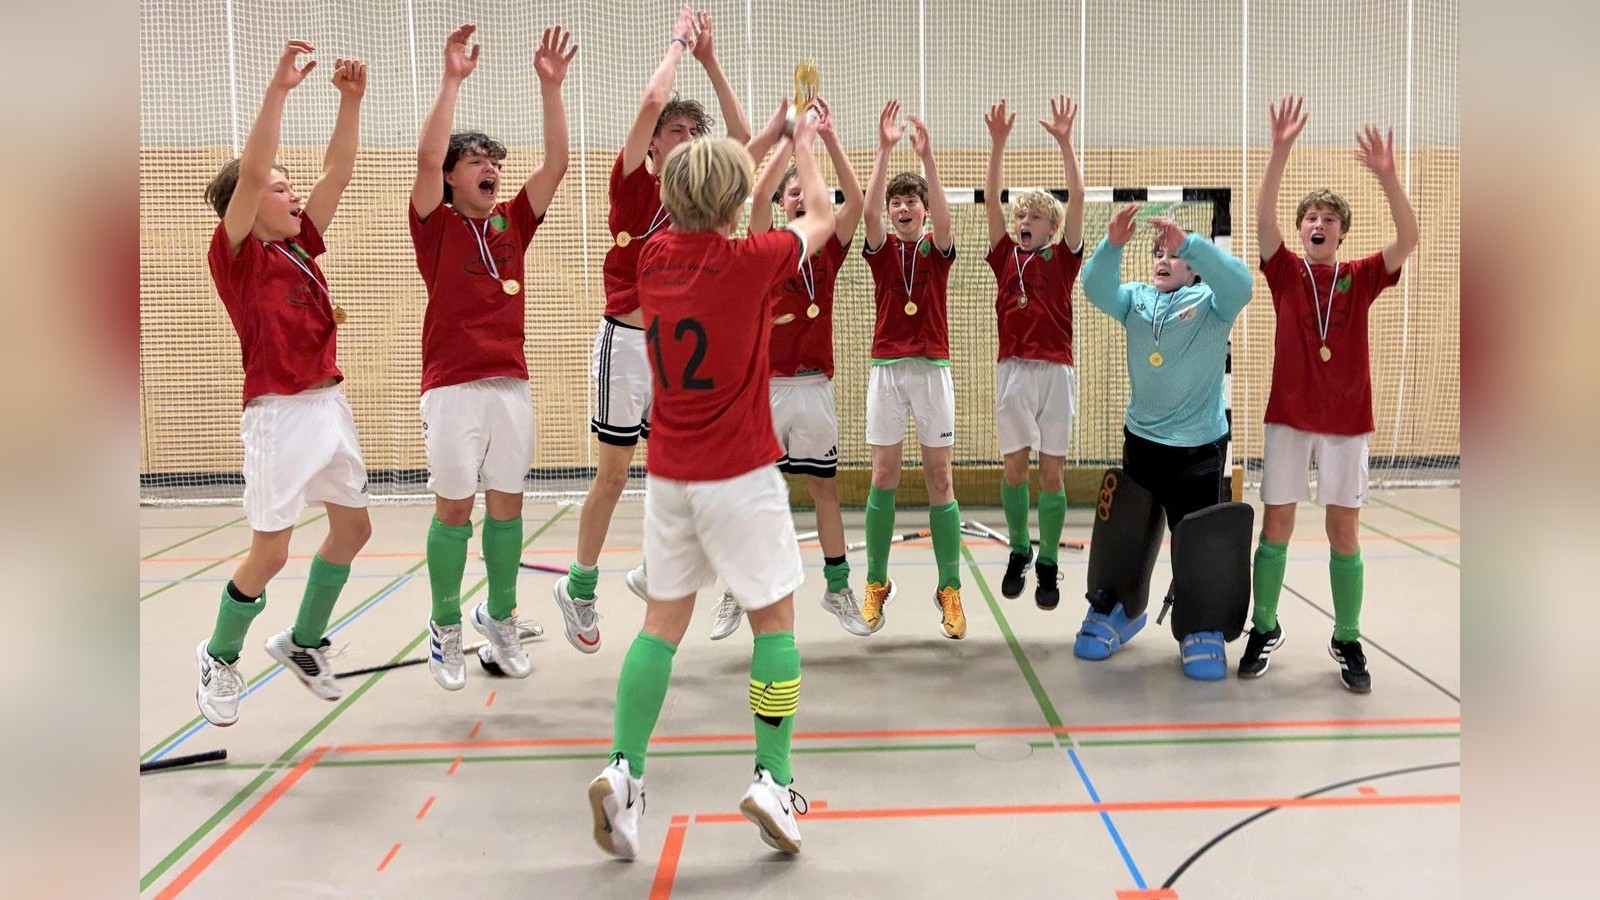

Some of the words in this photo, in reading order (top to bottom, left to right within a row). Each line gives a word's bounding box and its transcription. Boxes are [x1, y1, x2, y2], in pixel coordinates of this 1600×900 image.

[645, 314, 715, 391] 12
[940, 431, 953, 439] JAKO
[1097, 473, 1118, 521] OBO
